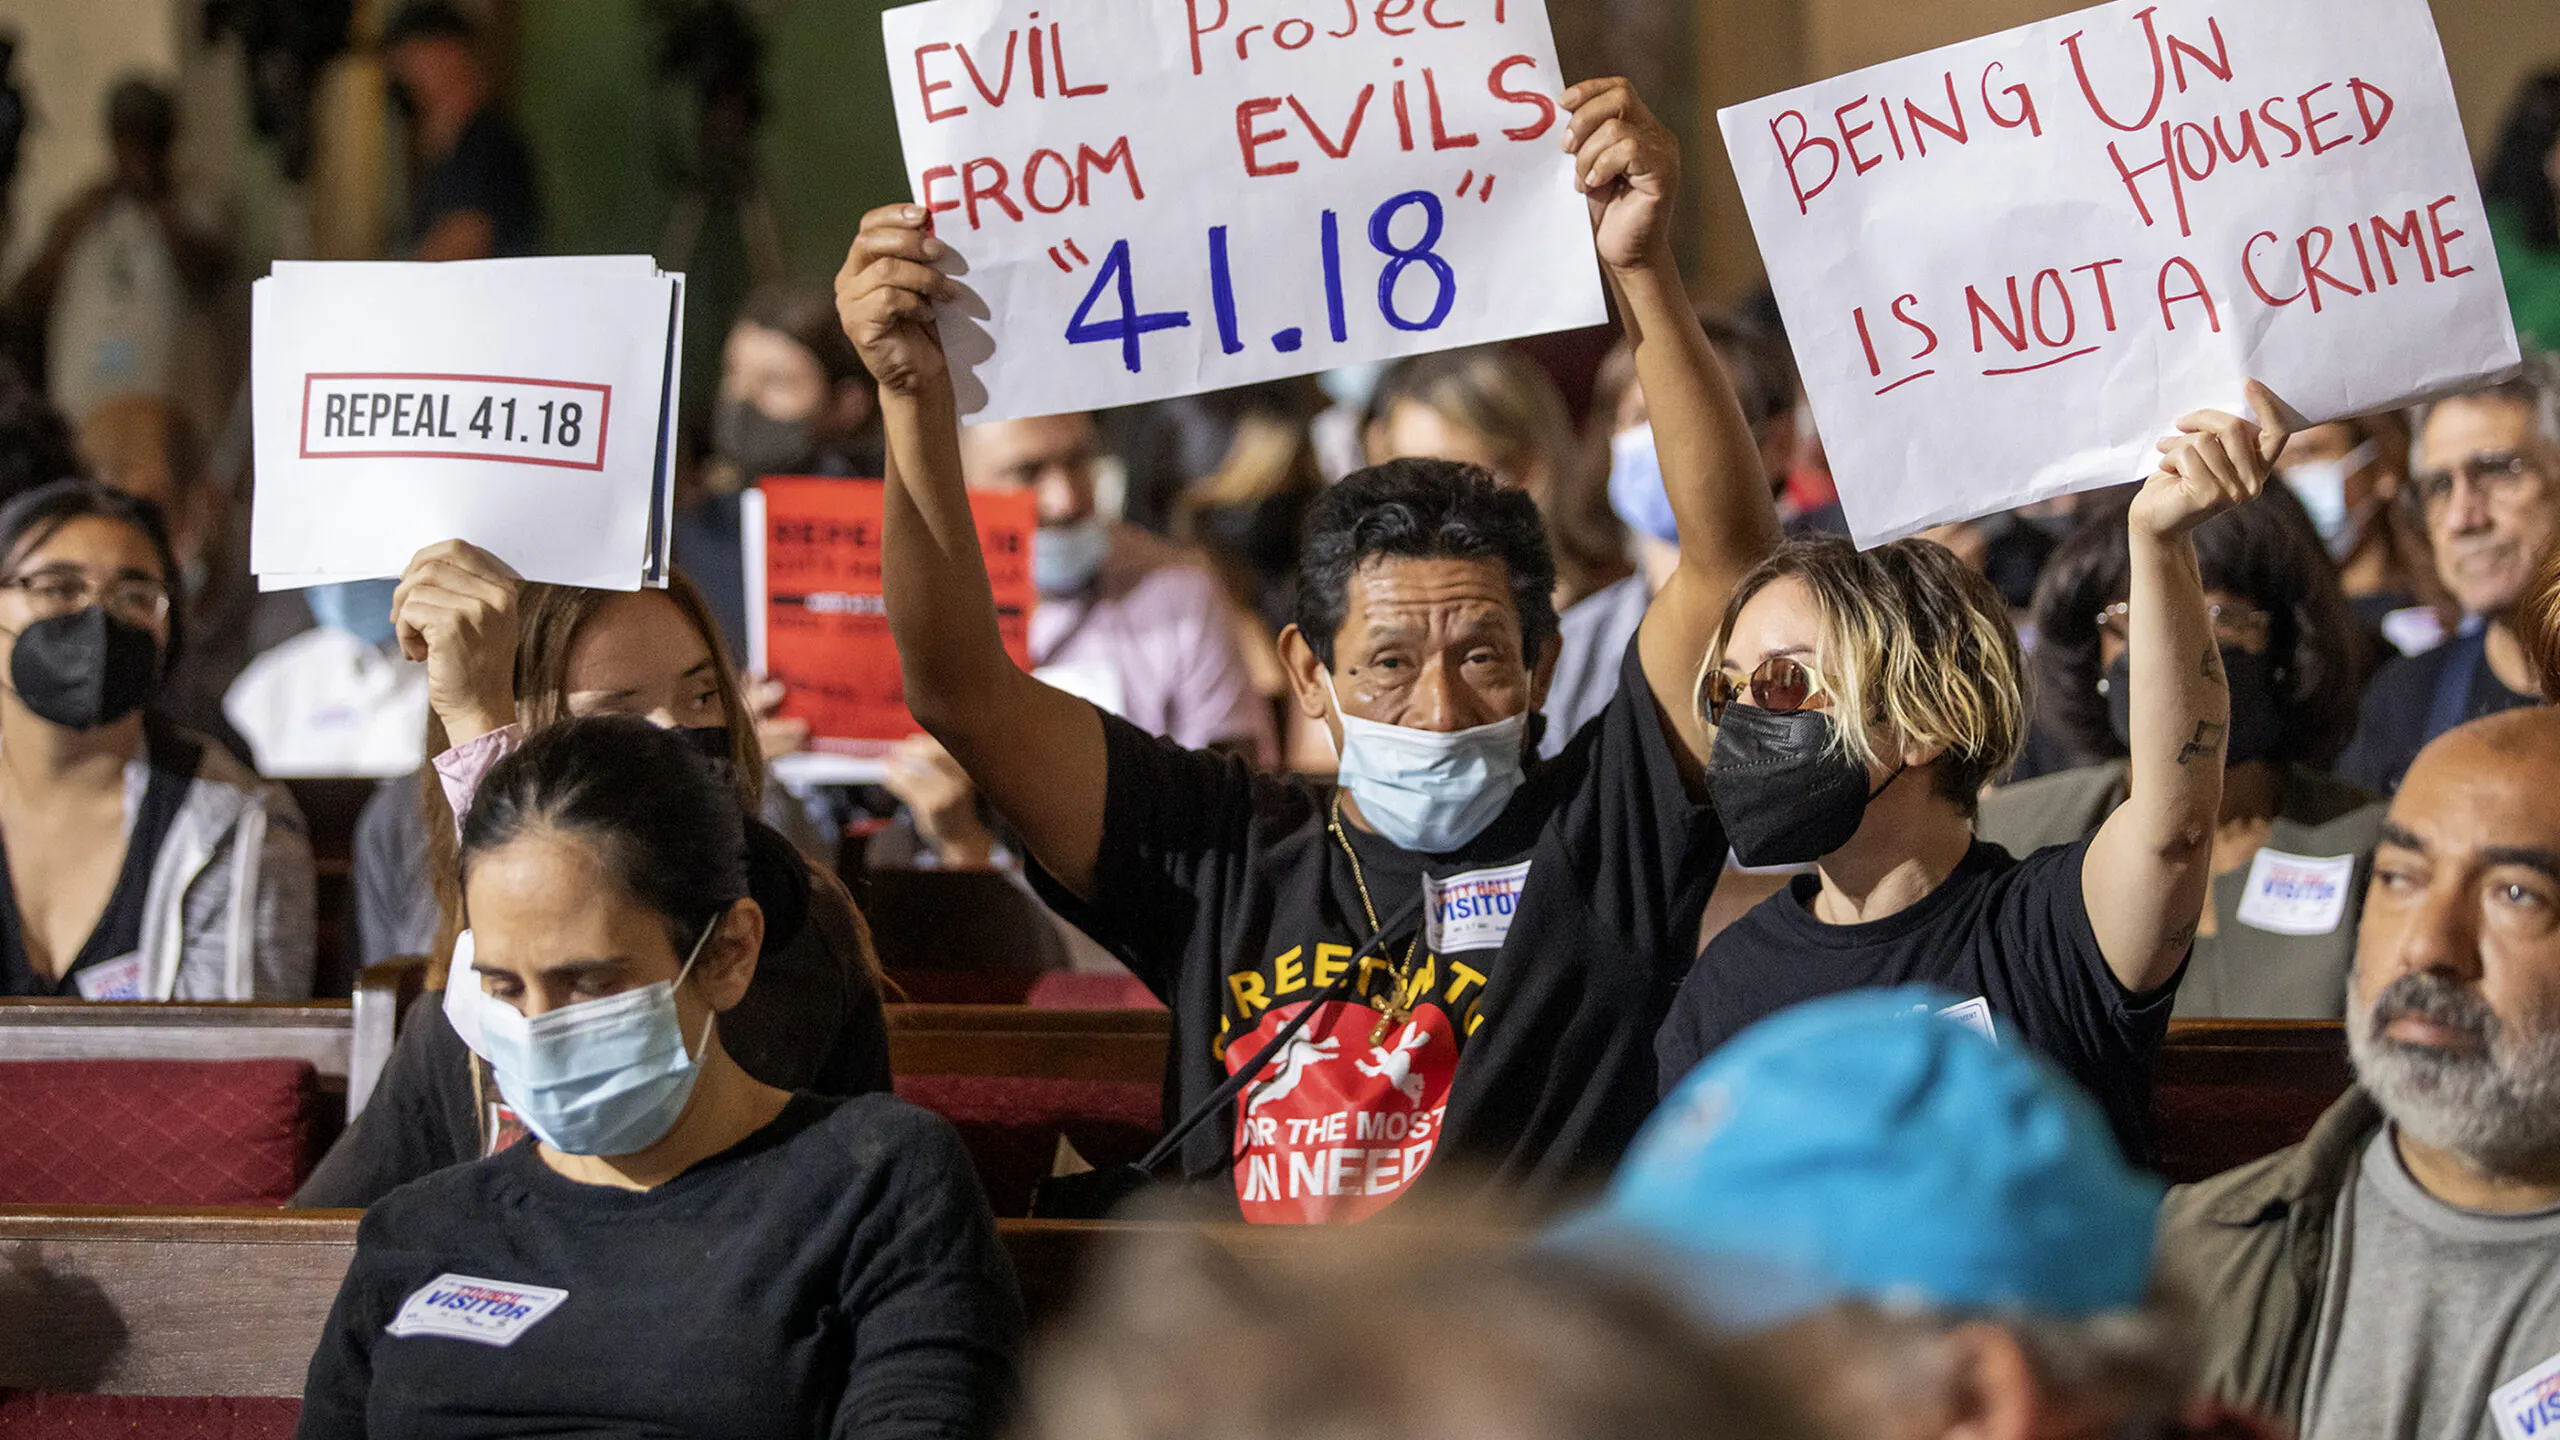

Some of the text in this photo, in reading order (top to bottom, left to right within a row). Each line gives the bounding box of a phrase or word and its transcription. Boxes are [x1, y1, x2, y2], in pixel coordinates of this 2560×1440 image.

[1769, 61, 2042, 215] BEING
[922, 136, 1145, 237] FROM
[1853, 194, 2475, 377] IS NOT A CRIME
[324, 393, 584, 448] REPEAL 41.18
[1286, 1111, 1348, 1146] THE
[1356, 1105, 1447, 1142] MOST
[1242, 1139, 1433, 1202] IN NEED
[426, 1290, 531, 1320] VISITOR
